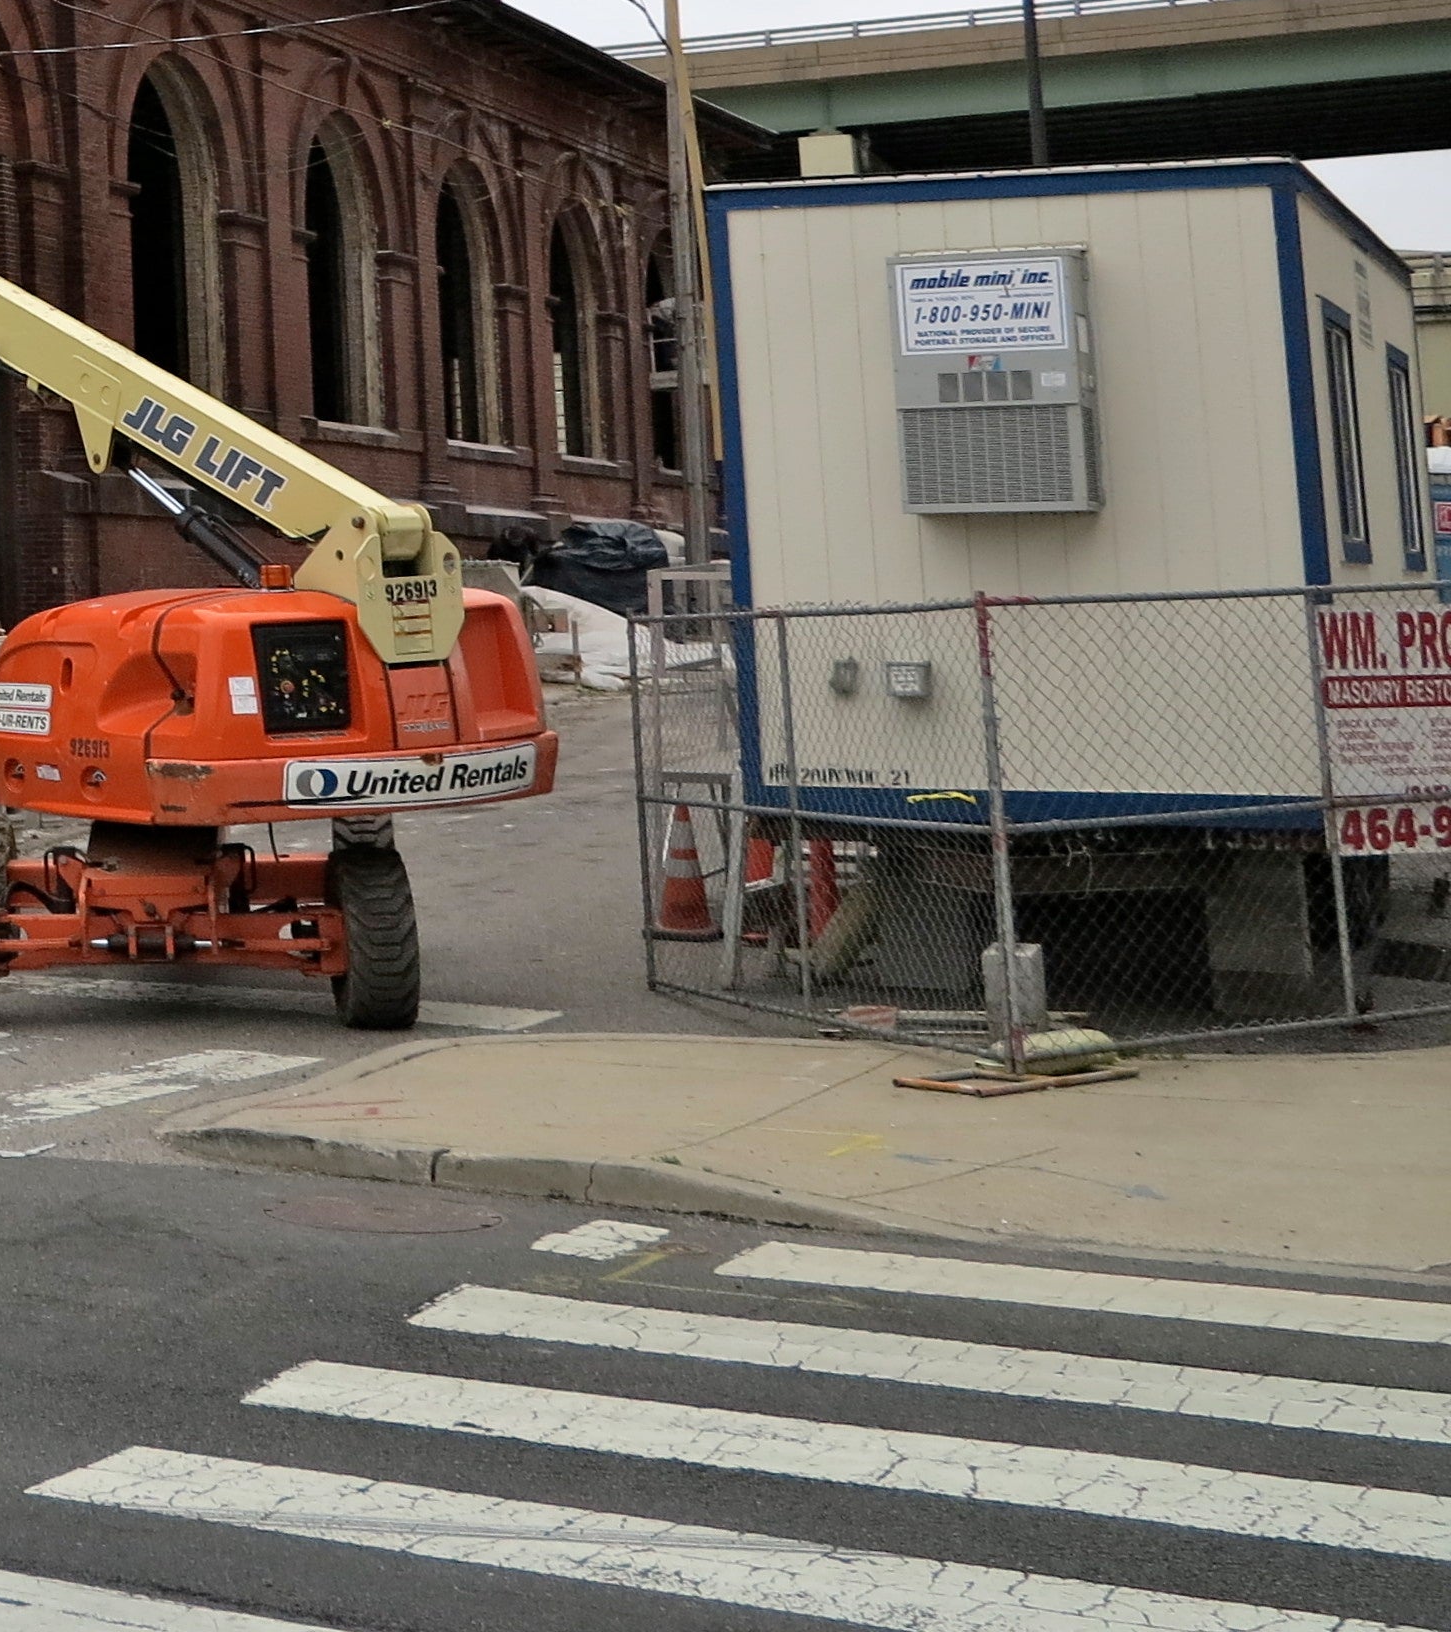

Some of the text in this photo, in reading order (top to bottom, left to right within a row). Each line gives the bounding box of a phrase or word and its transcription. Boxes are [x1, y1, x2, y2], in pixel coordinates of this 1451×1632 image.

[909, 268, 970, 290] mobile
[1021, 268, 1053, 284] inc.
[914, 301, 1051, 324] 1-800-950-MINI
[914, 334, 1055, 346] PORTABLE STORAGE AND OFFICES
[917, 330, 957, 338] NATIONAL
[961, 328, 1002, 336] PROVIDER
[1017, 326, 1051, 334] SECURE
[121, 395, 288, 508] JLG LIFT
[385, 579, 437, 602] 926913
[1318, 611, 1388, 670] WM.
[15, 688, 47, 703] Rentals
[1327, 679, 1402, 705] MASONRY
[70, 738, 111, 759] 926913
[347, 755, 528, 796] United Rentals
[1341, 807, 1451, 851] 464-9
